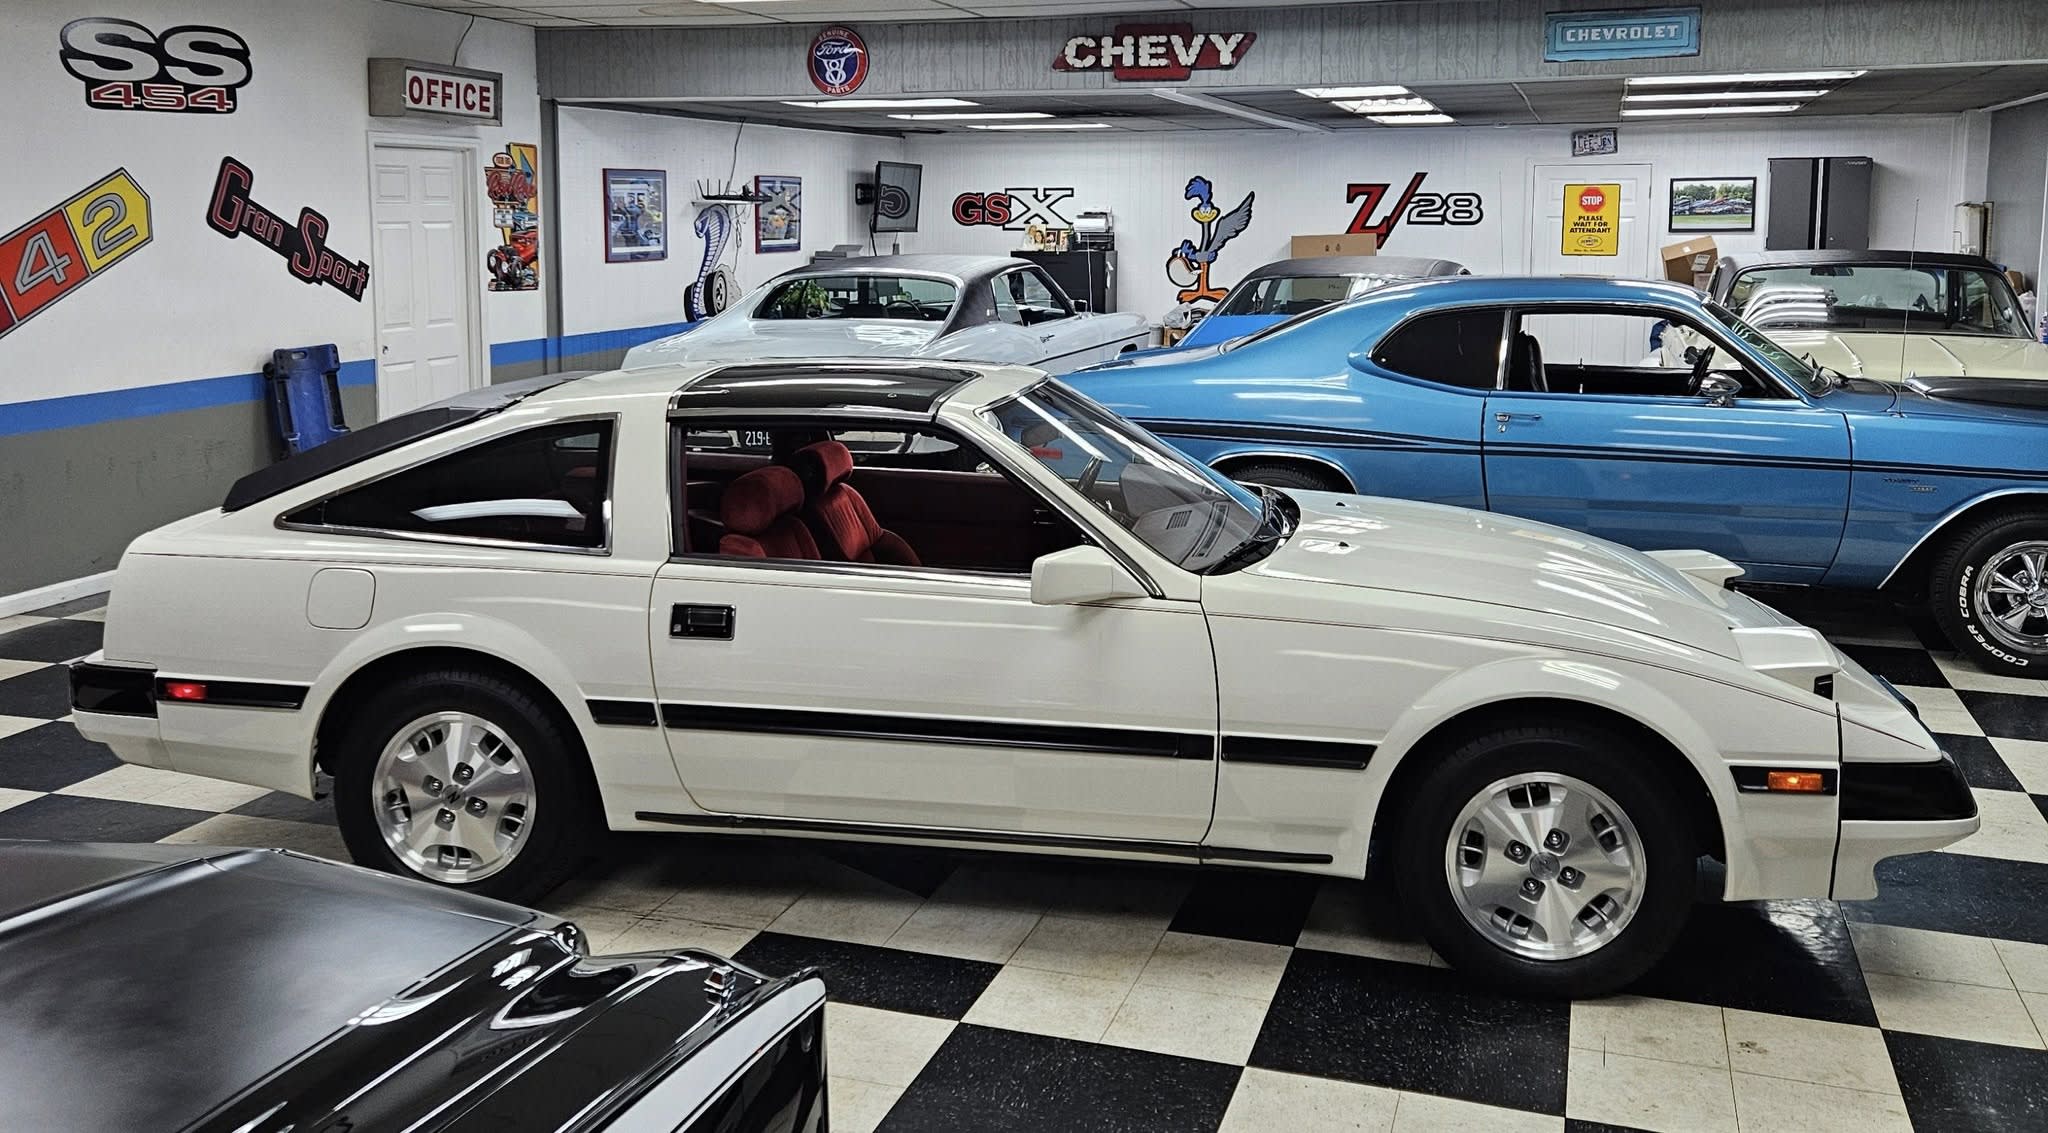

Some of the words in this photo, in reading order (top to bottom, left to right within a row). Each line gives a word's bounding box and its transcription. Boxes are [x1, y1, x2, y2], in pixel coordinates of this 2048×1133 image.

[61, 18, 251, 87] SS
[816, 41, 864, 56] Ford
[1064, 33, 1245, 68] CHEVY
[1566, 25, 1679, 42] CHEVROLET
[91, 82, 233, 112] 454
[408, 75, 491, 113] OFFICE
[827, 85, 850, 94] PARTS
[952, 187, 1074, 231] GSX
[1345, 172, 1484, 249] Z/28
[1581, 195, 1603, 206] STOP
[211, 162, 284, 247] Gran
[292, 212, 366, 295] Sport
[1959, 565, 1974, 618] COBRA
[1967, 624, 2029, 666] COOPER
